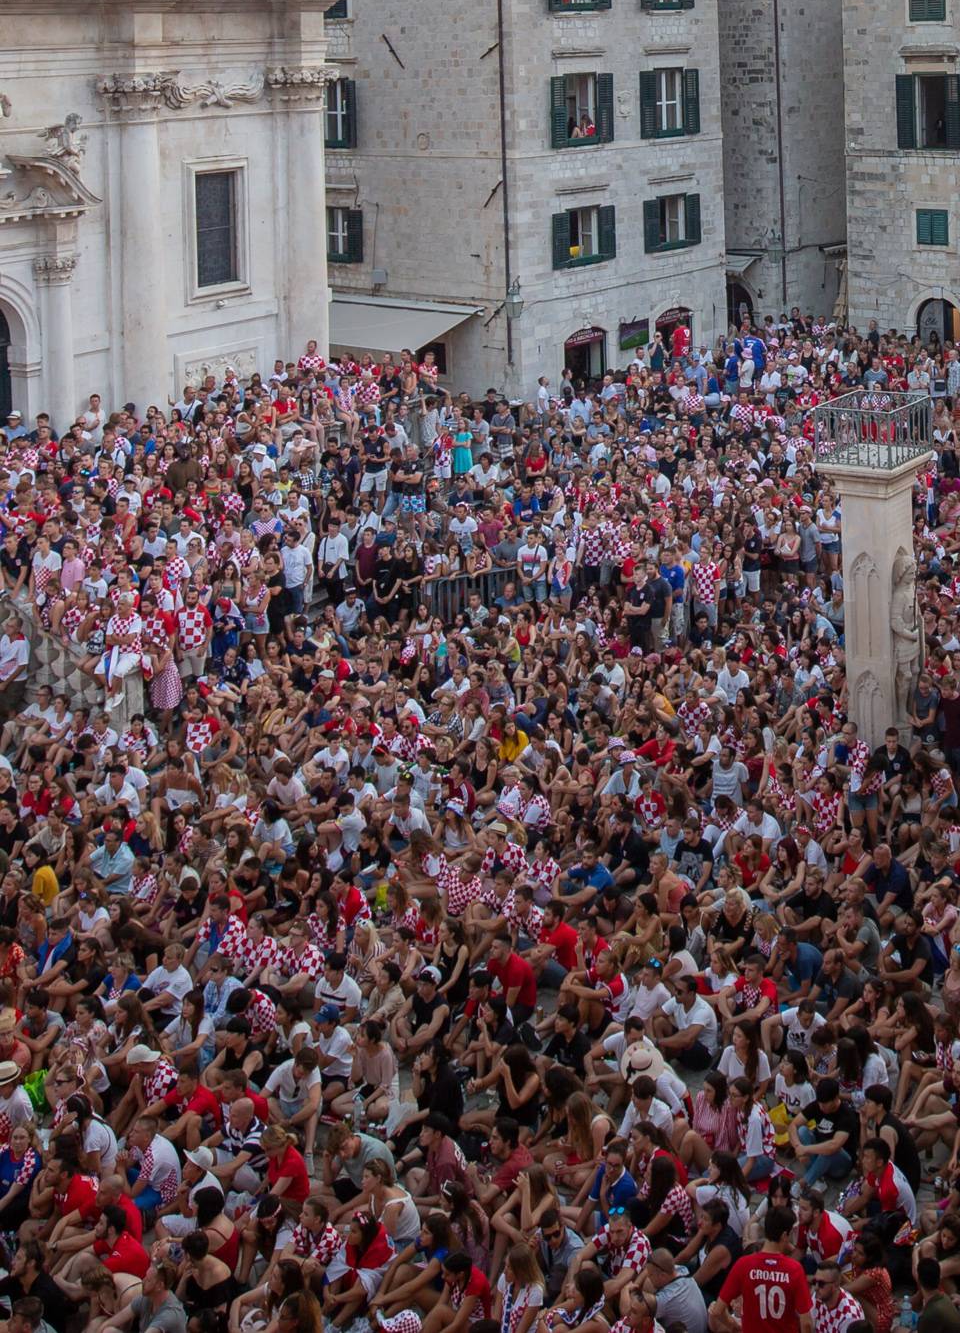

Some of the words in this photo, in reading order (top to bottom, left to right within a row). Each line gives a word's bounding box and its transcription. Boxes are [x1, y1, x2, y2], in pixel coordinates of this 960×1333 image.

[779, 1091, 801, 1107] FILA
[749, 1269, 790, 1284] CROATIA
[754, 1284, 786, 1320] 10
